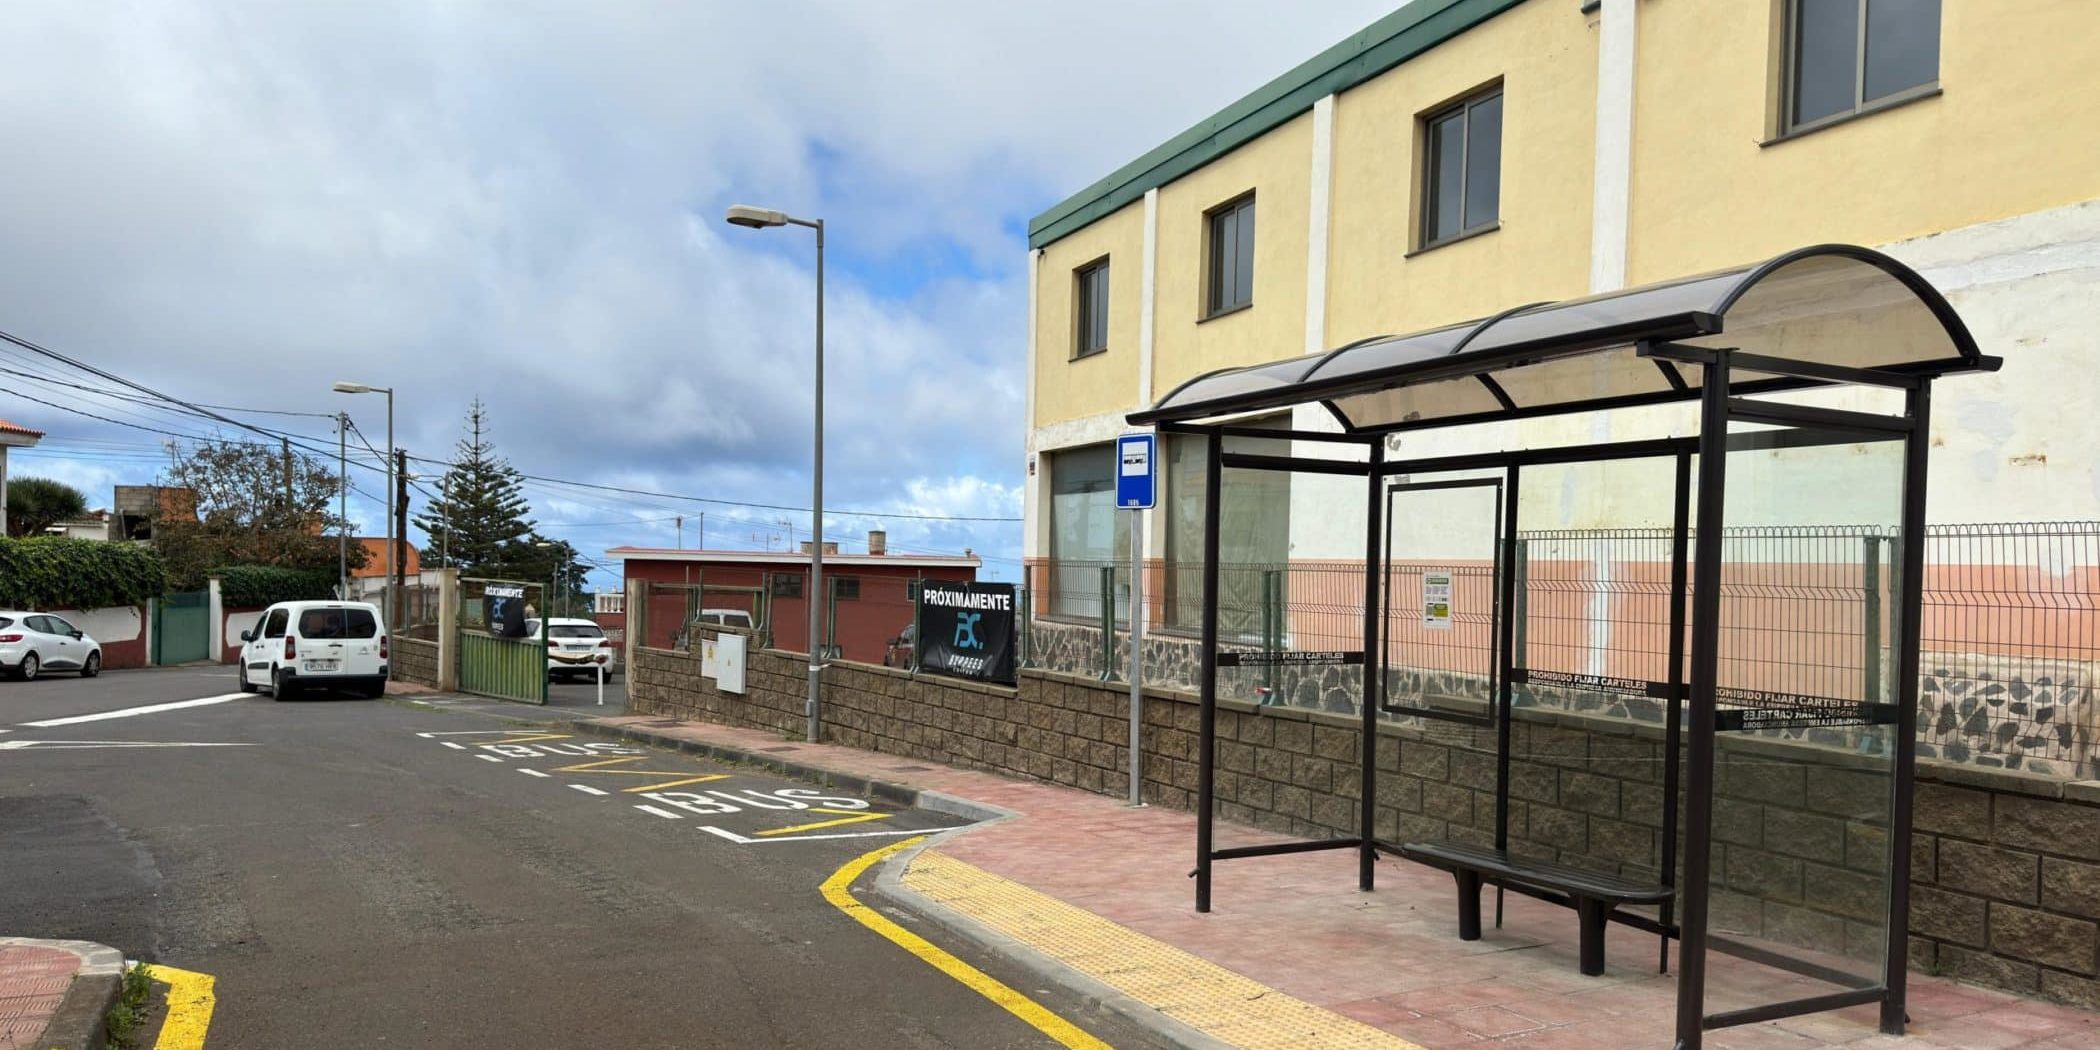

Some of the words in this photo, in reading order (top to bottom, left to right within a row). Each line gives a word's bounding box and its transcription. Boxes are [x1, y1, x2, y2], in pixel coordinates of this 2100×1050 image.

[485, 584, 524, 599] RÓXIMAMENTE
[924, 587, 1010, 610] PRÓXIMAMENTE
[1528, 671, 1572, 681] PROHIBIDO
[1574, 676, 1599, 685] FIJAR
[1600, 677, 1647, 690] CARTELES
[1716, 688, 1762, 701] OHIBIDO
[1764, 693, 1796, 705] FIJAR
[640, 789, 870, 814] BUS
